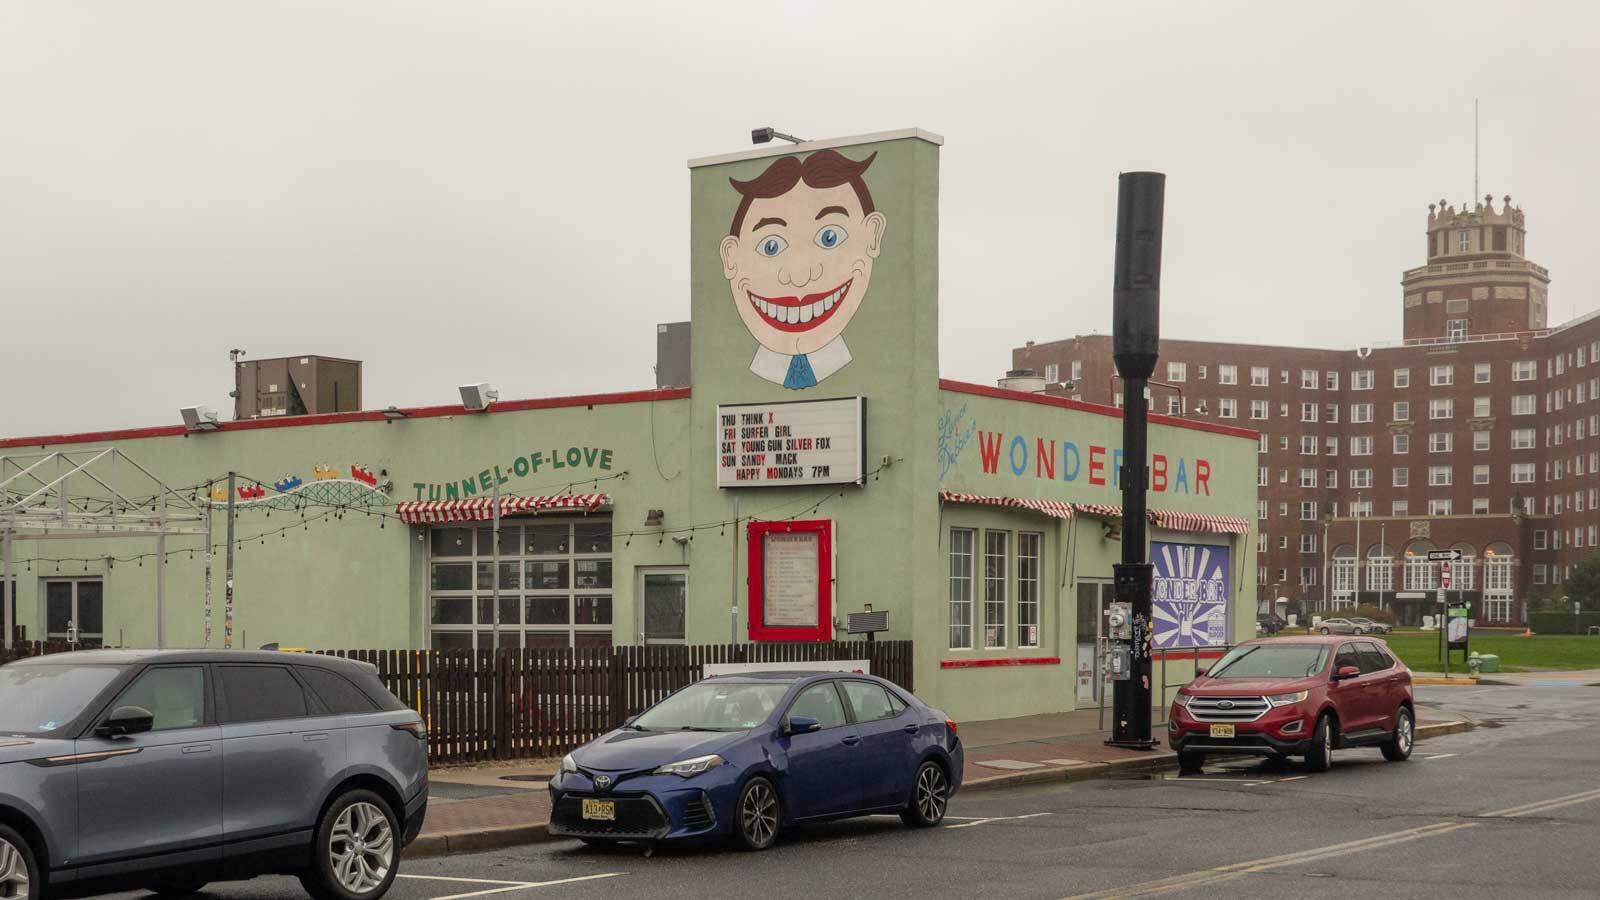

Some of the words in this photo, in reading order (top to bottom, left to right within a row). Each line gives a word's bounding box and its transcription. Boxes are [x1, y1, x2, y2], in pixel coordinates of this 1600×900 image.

[722, 415, 736, 426] THU
[741, 413, 763, 425] THINK
[768, 412, 774, 424] X
[724, 428, 736, 440] FRI
[741, 427, 769, 439] SURFER
[775, 425, 792, 437] GIRL
[722, 442, 736, 453] SAT
[741, 441, 765, 453] YOUNG
[768, 440, 782, 451] GUN
[786, 438, 812, 451] SILVER
[816, 437, 831, 449] FOX
[722, 455, 736, 467] SUN
[741, 454, 765, 466] SANDY
[776, 453, 797, 465] MACK
[736, 468, 760, 480] HAPPY
[767, 467, 803, 479] MONDAYS
[812, 465, 830, 478] 7PM
[1152, 453, 1211, 496] BAR
[1199, 579, 1227, 605] BAR
